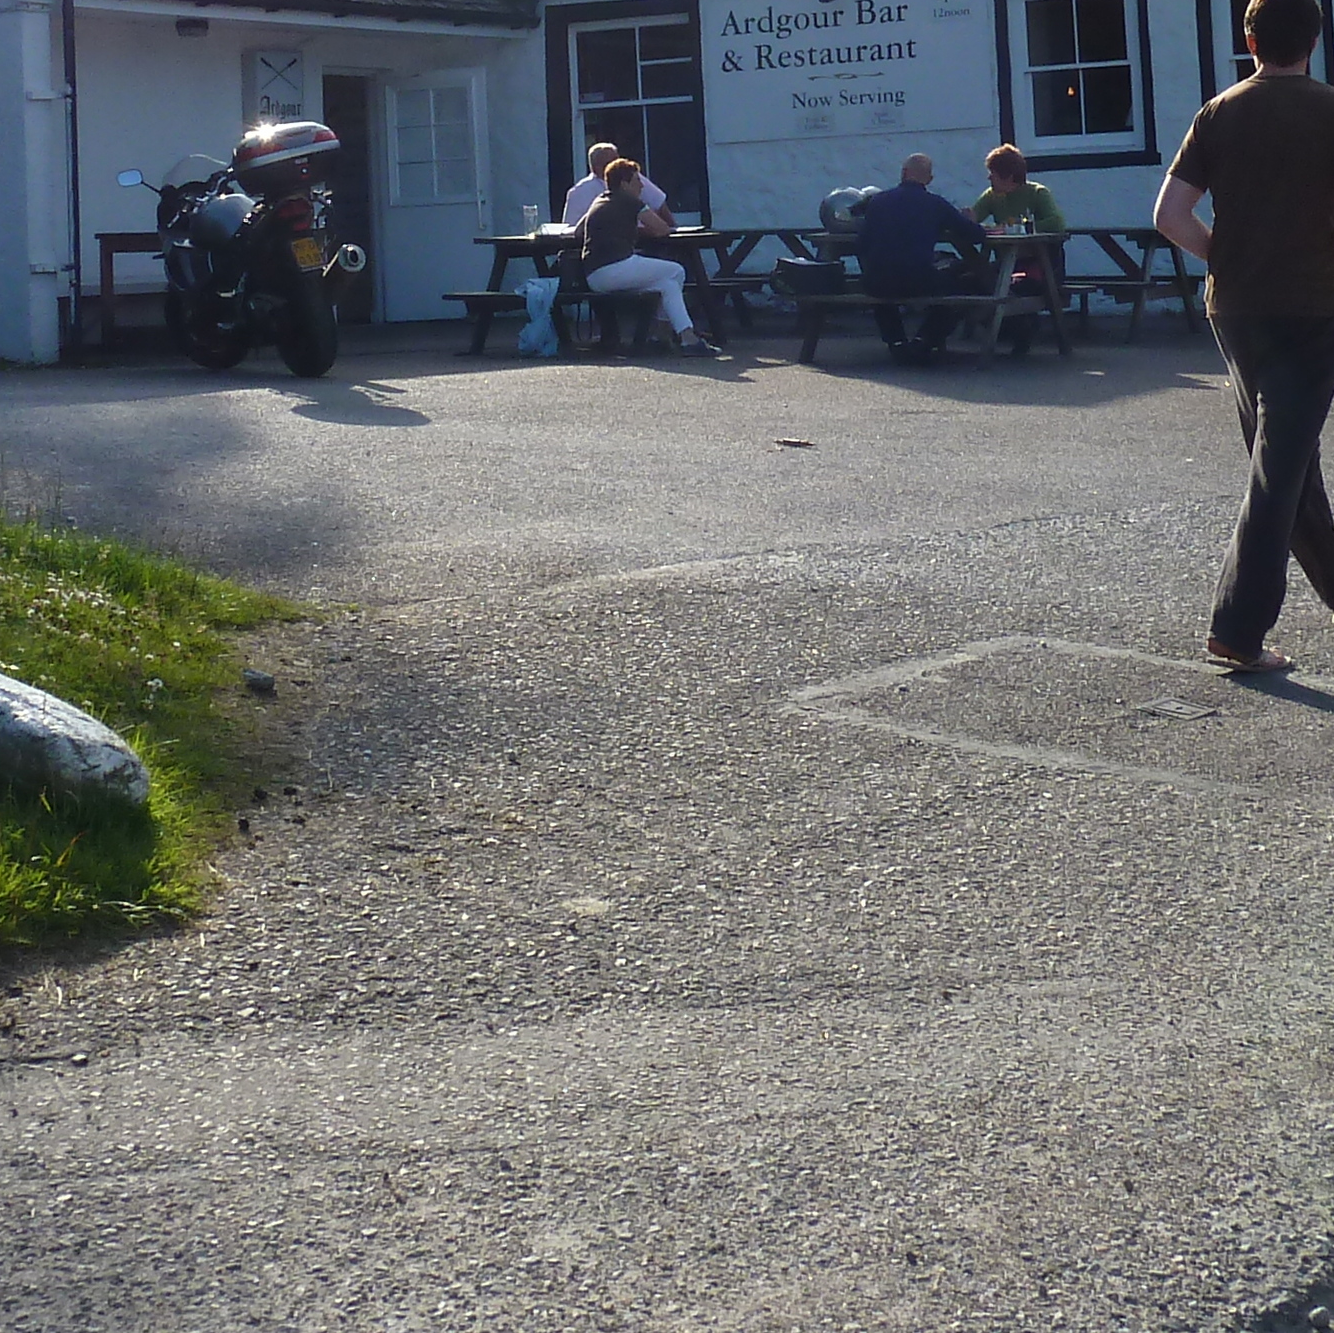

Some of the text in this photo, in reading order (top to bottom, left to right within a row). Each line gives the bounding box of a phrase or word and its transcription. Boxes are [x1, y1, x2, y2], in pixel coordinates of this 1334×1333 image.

[720, 6, 845, 40] Ardgour
[932, 7, 971, 19] 12noon
[721, 38, 918, 73] & Restaurant
[791, 87, 906, 110] Now Serving
